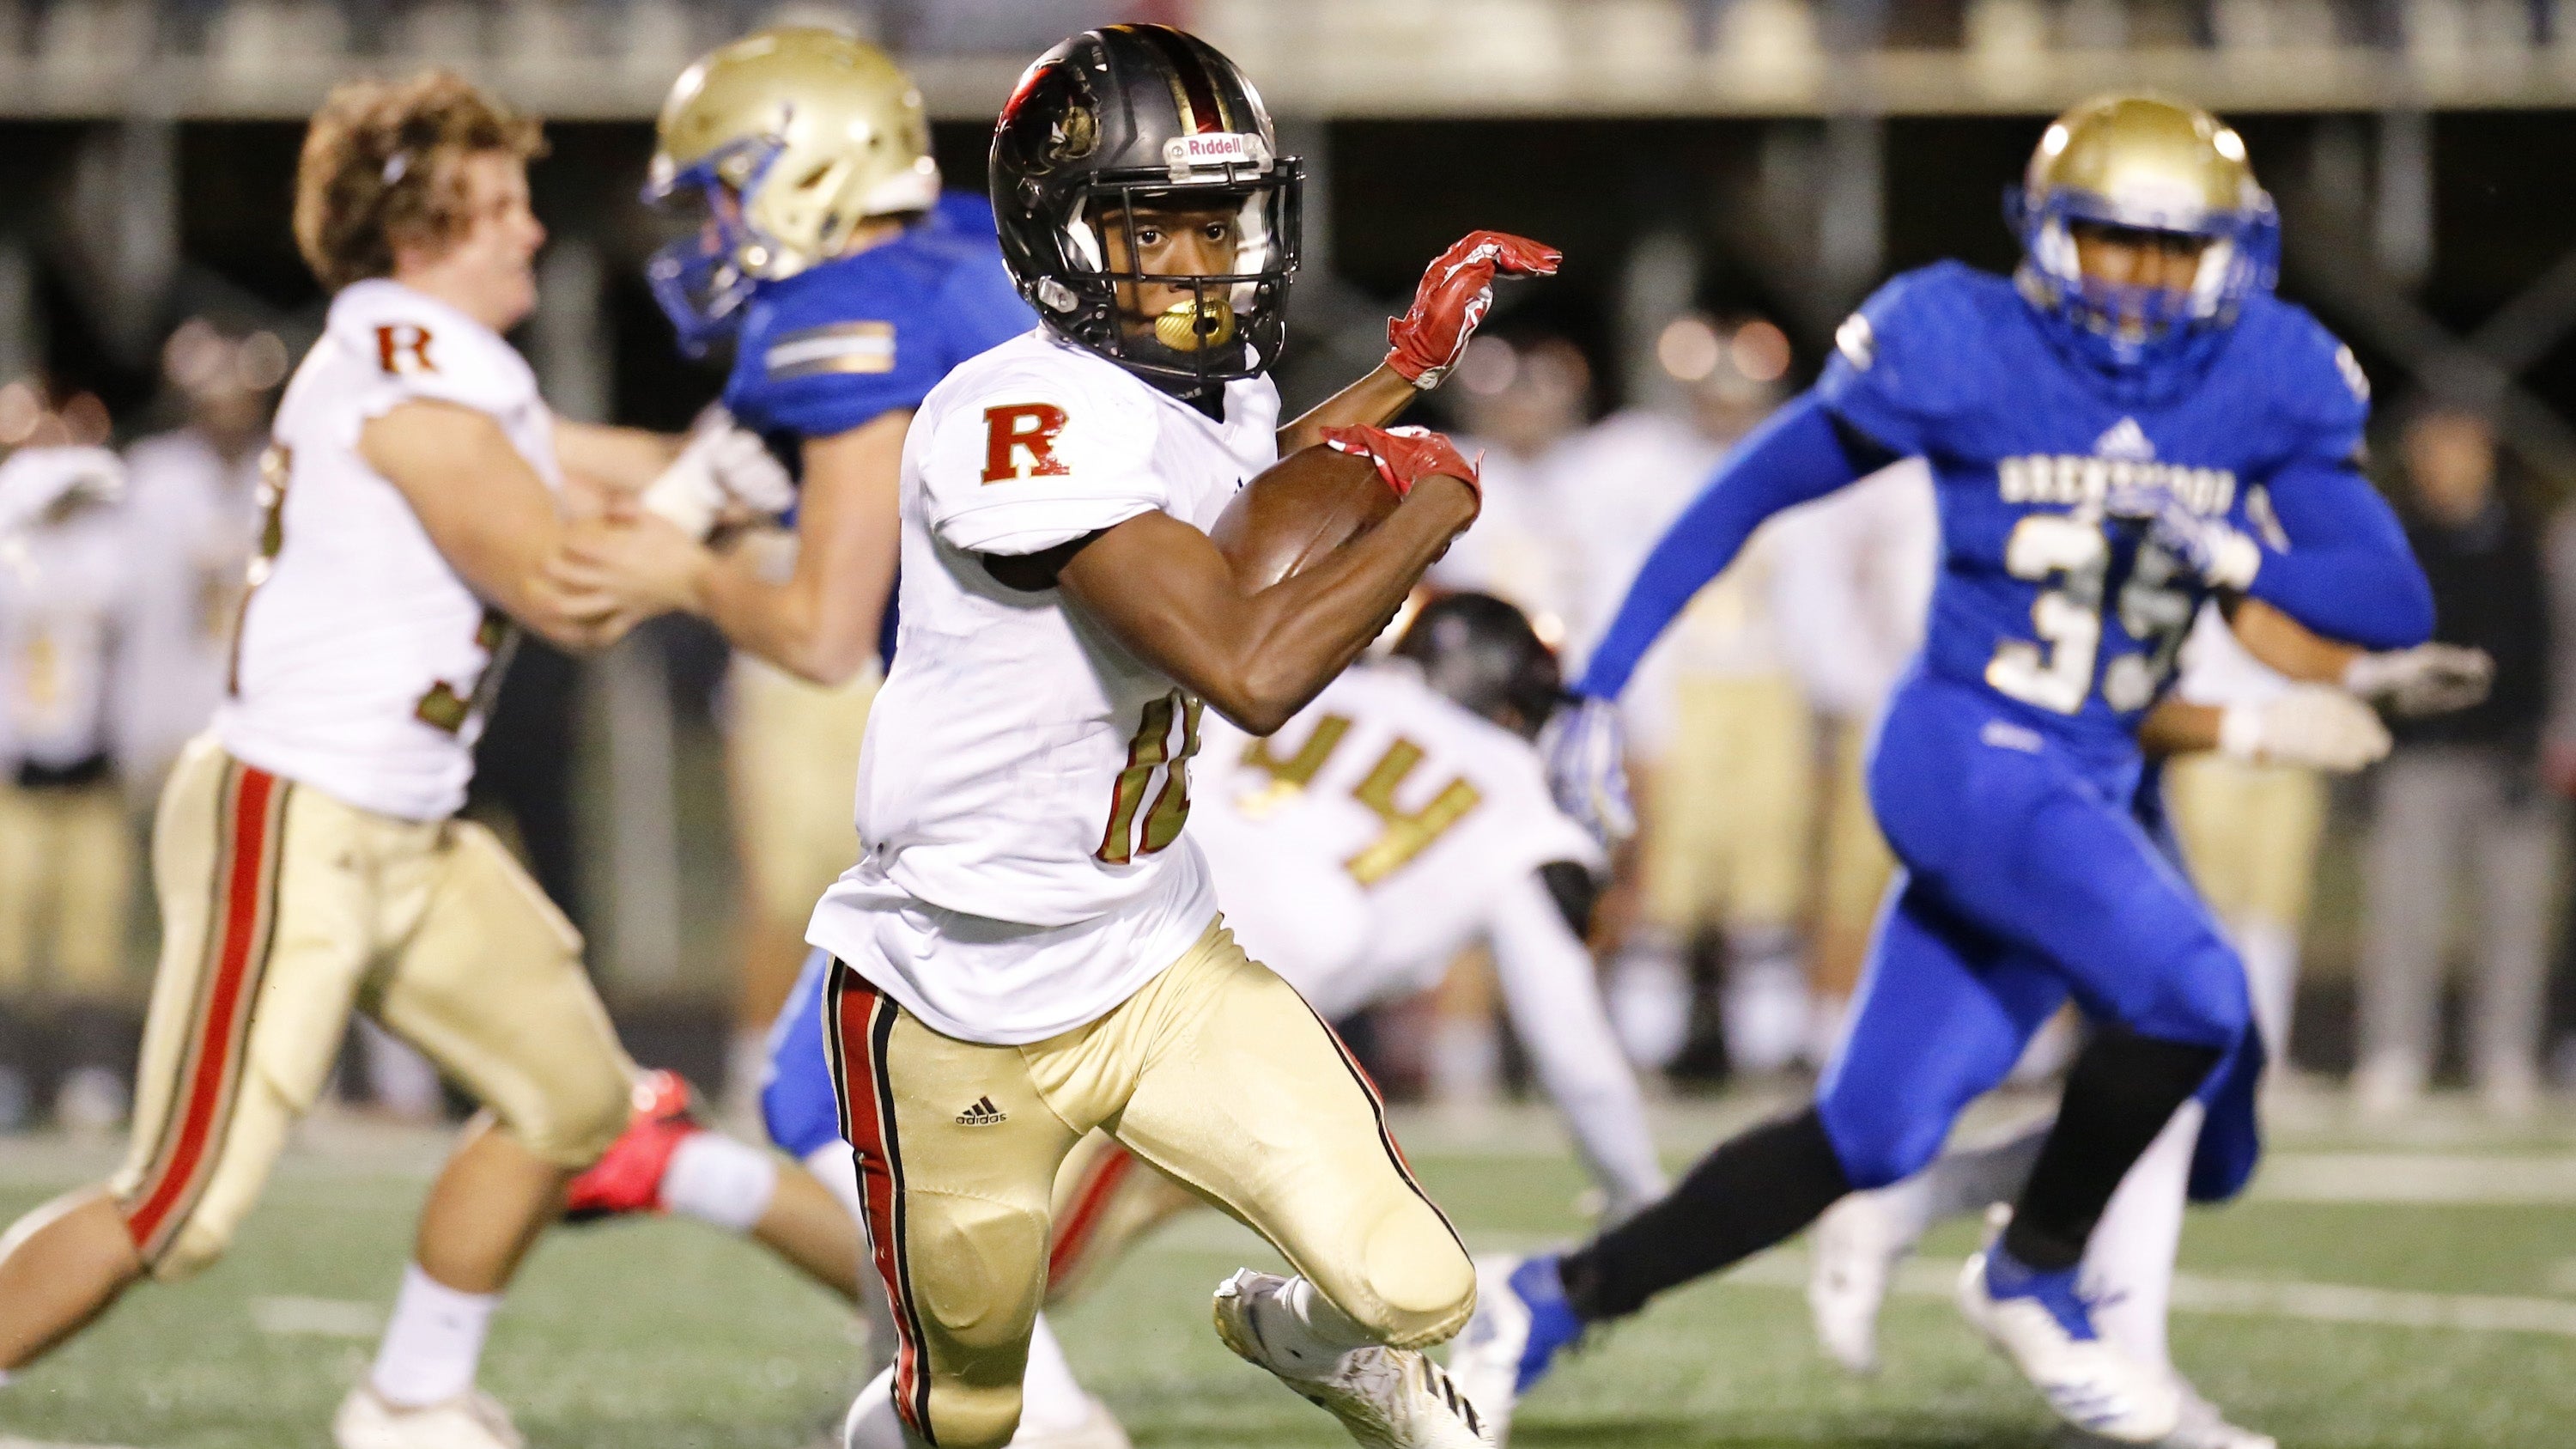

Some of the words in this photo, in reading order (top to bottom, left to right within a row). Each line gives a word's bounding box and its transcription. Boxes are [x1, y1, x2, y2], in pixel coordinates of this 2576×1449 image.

[1188, 137, 1242, 155] Riddell
[981, 401, 1072, 487] R
[1236, 713, 1482, 888] 44
[955, 1113, 1007, 1125] adidas
